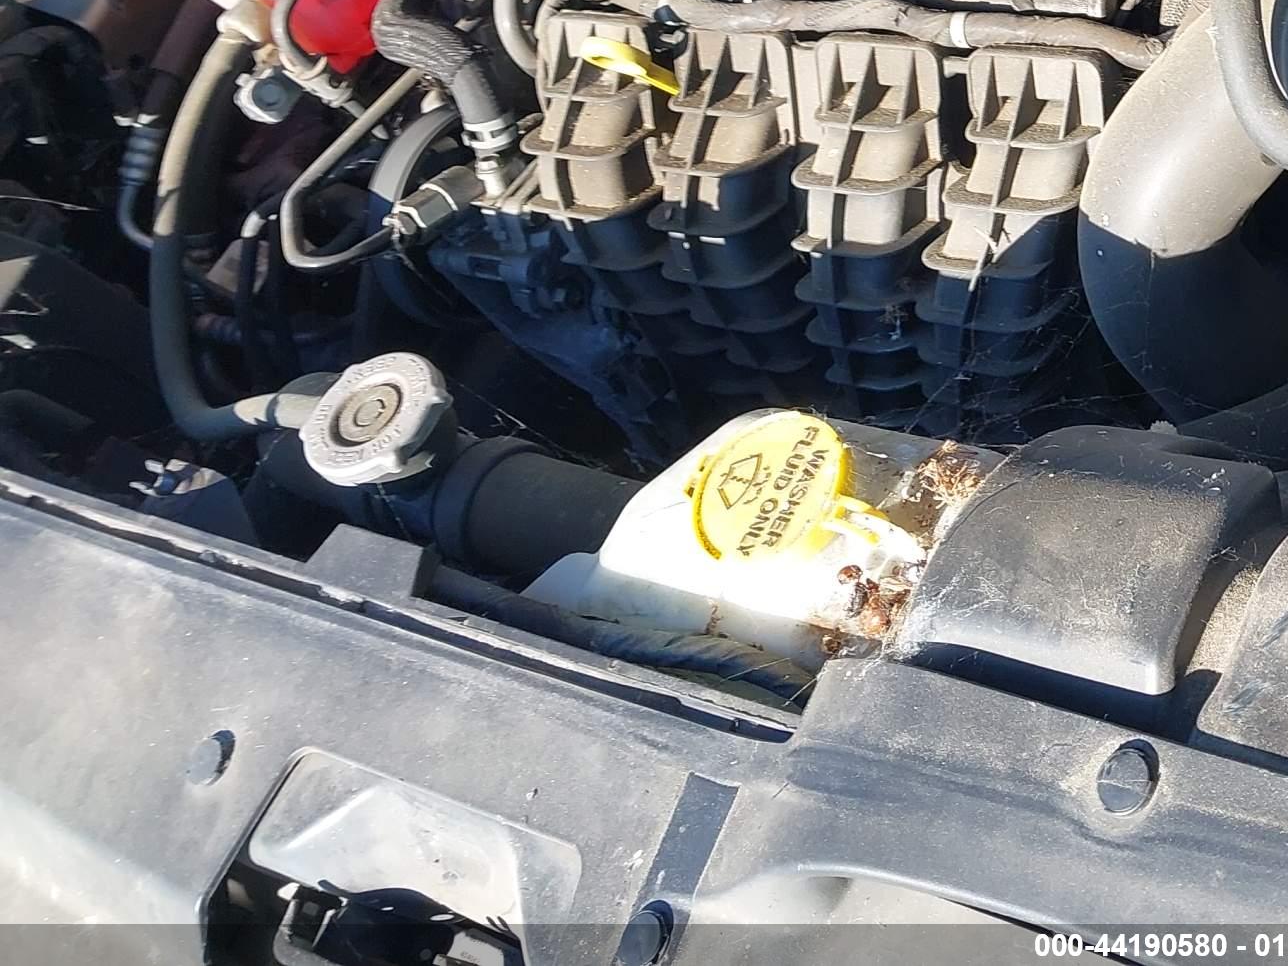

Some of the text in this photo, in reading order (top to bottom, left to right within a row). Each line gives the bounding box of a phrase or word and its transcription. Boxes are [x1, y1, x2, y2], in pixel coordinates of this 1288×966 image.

[736, 426, 819, 557] FLUID ONLY
[761, 449, 829, 547] WASHER
